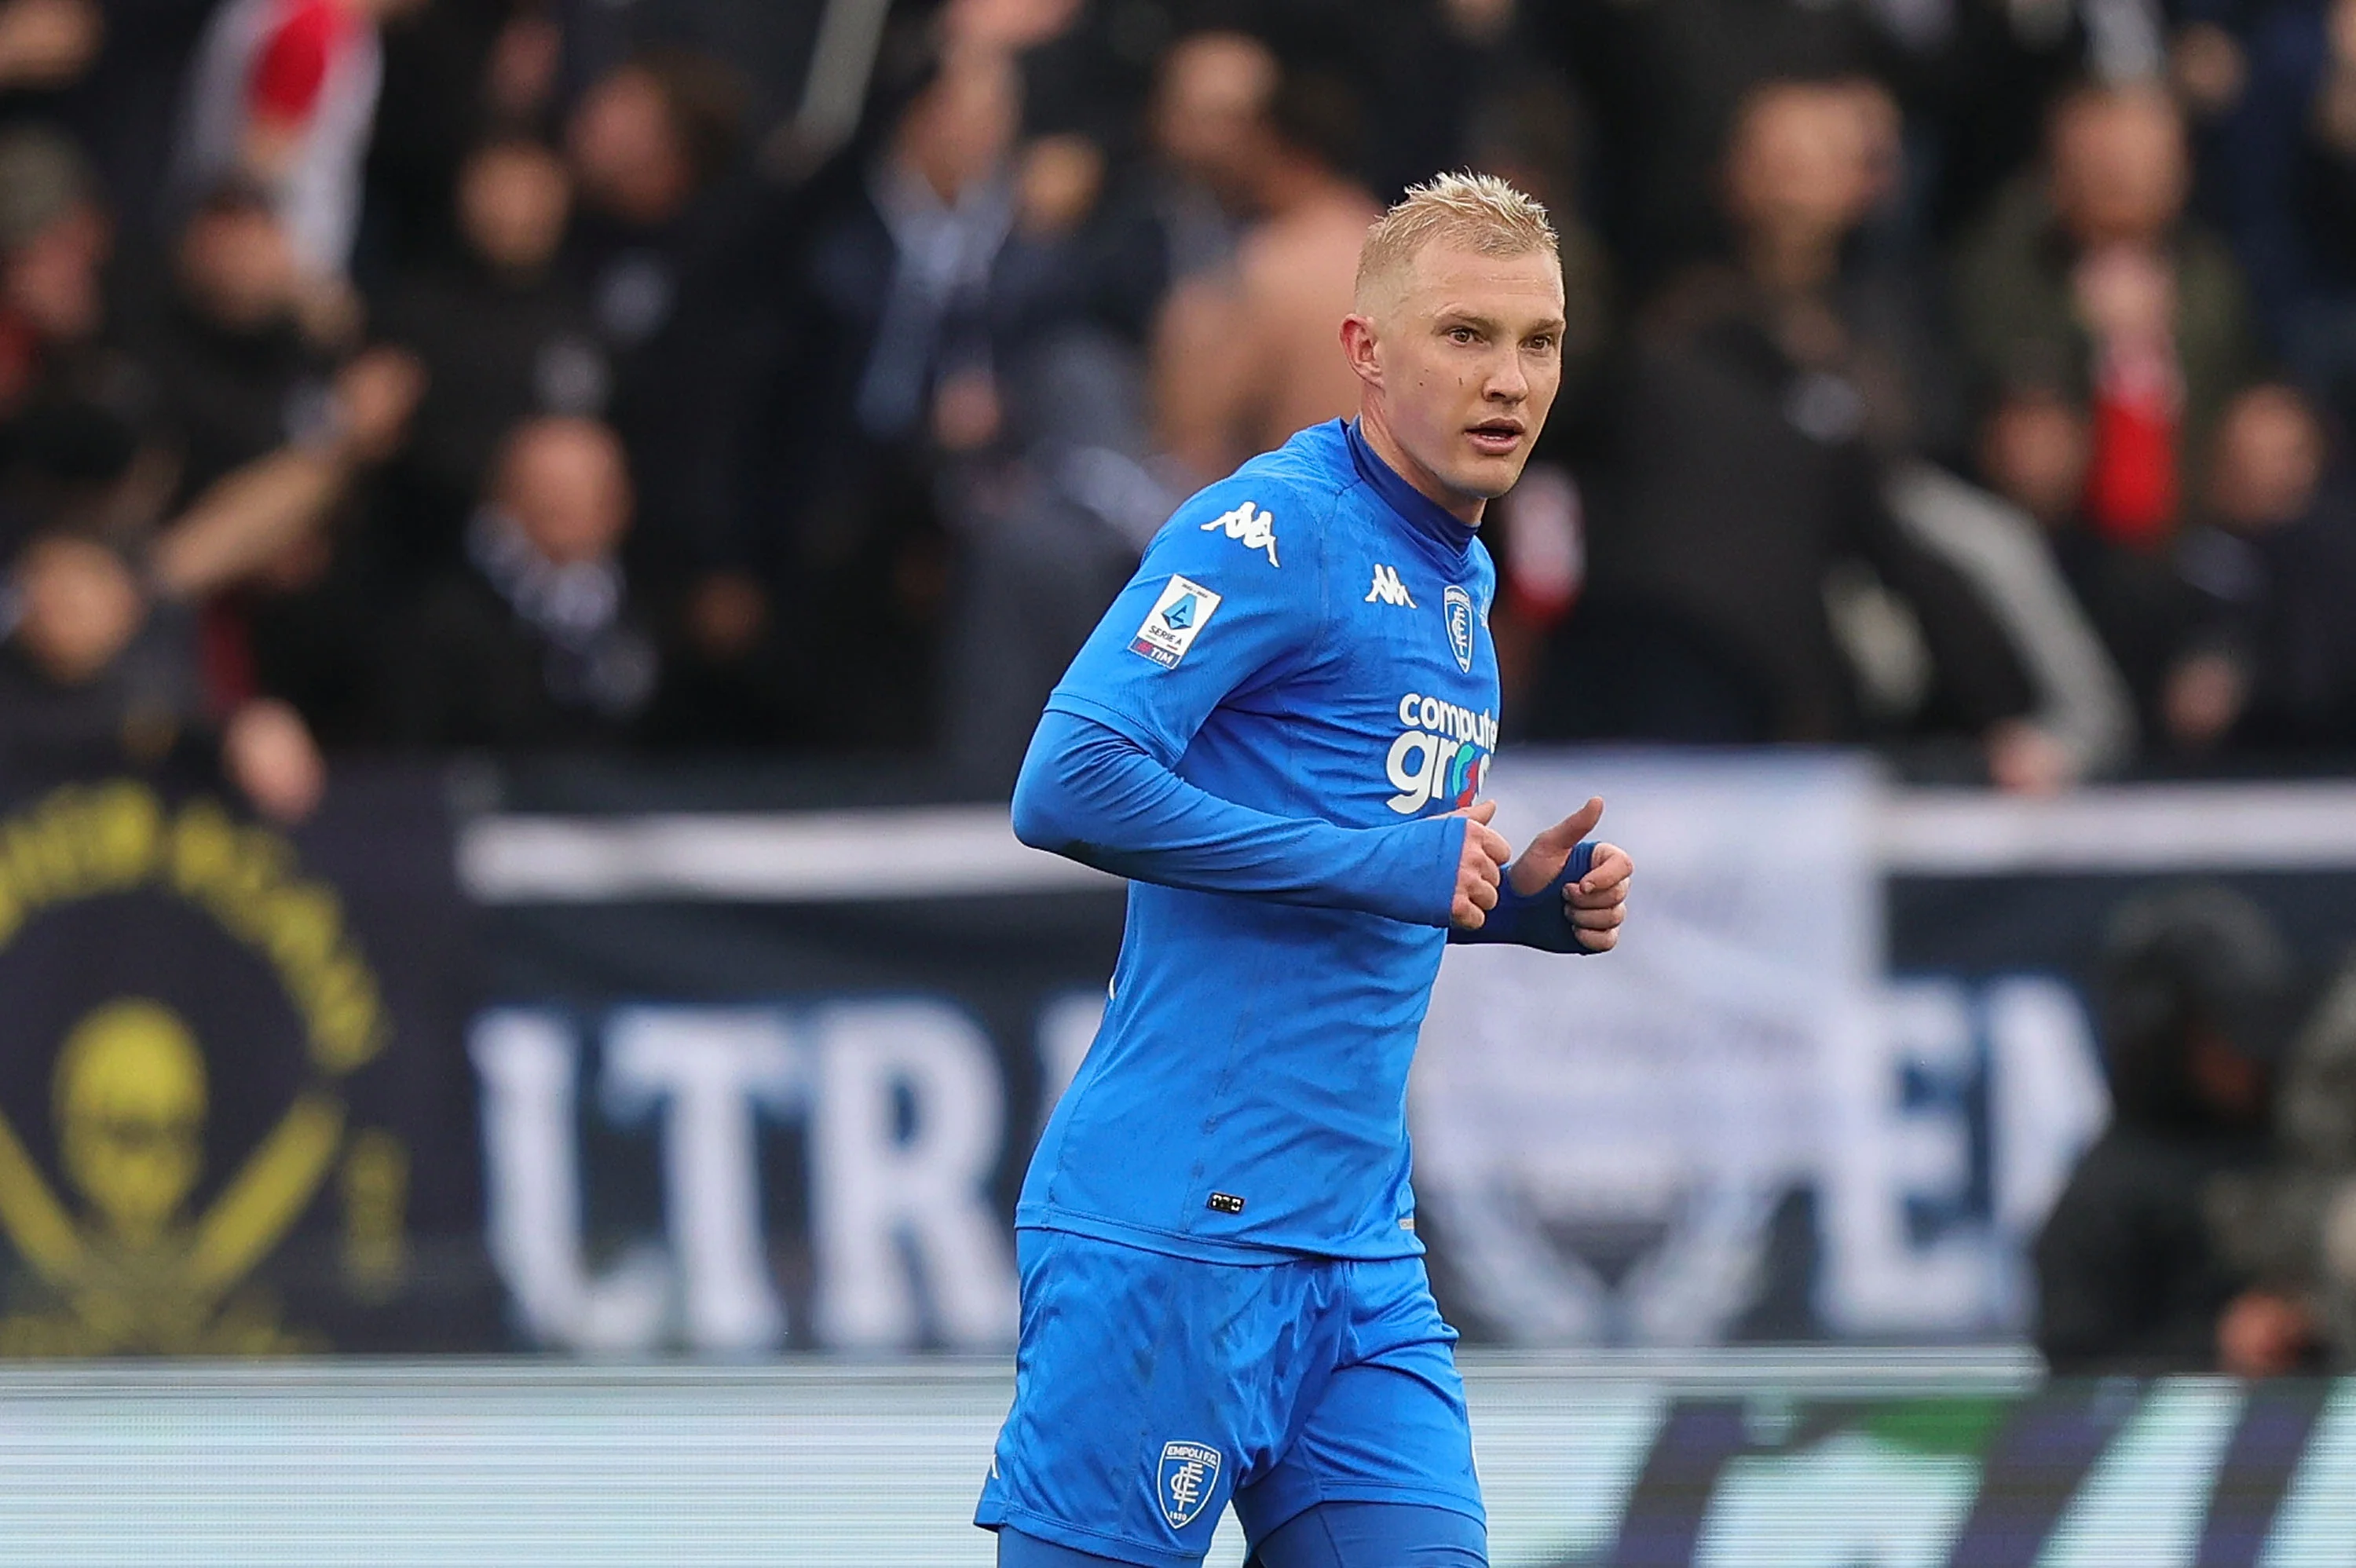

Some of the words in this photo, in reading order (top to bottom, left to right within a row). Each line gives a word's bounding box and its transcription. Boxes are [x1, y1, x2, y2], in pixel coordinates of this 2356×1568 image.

[1148, 625, 1176, 642] SERIE
[1151, 647, 1174, 664] TIM
[1166, 1446, 1204, 1460] EMPOLI
